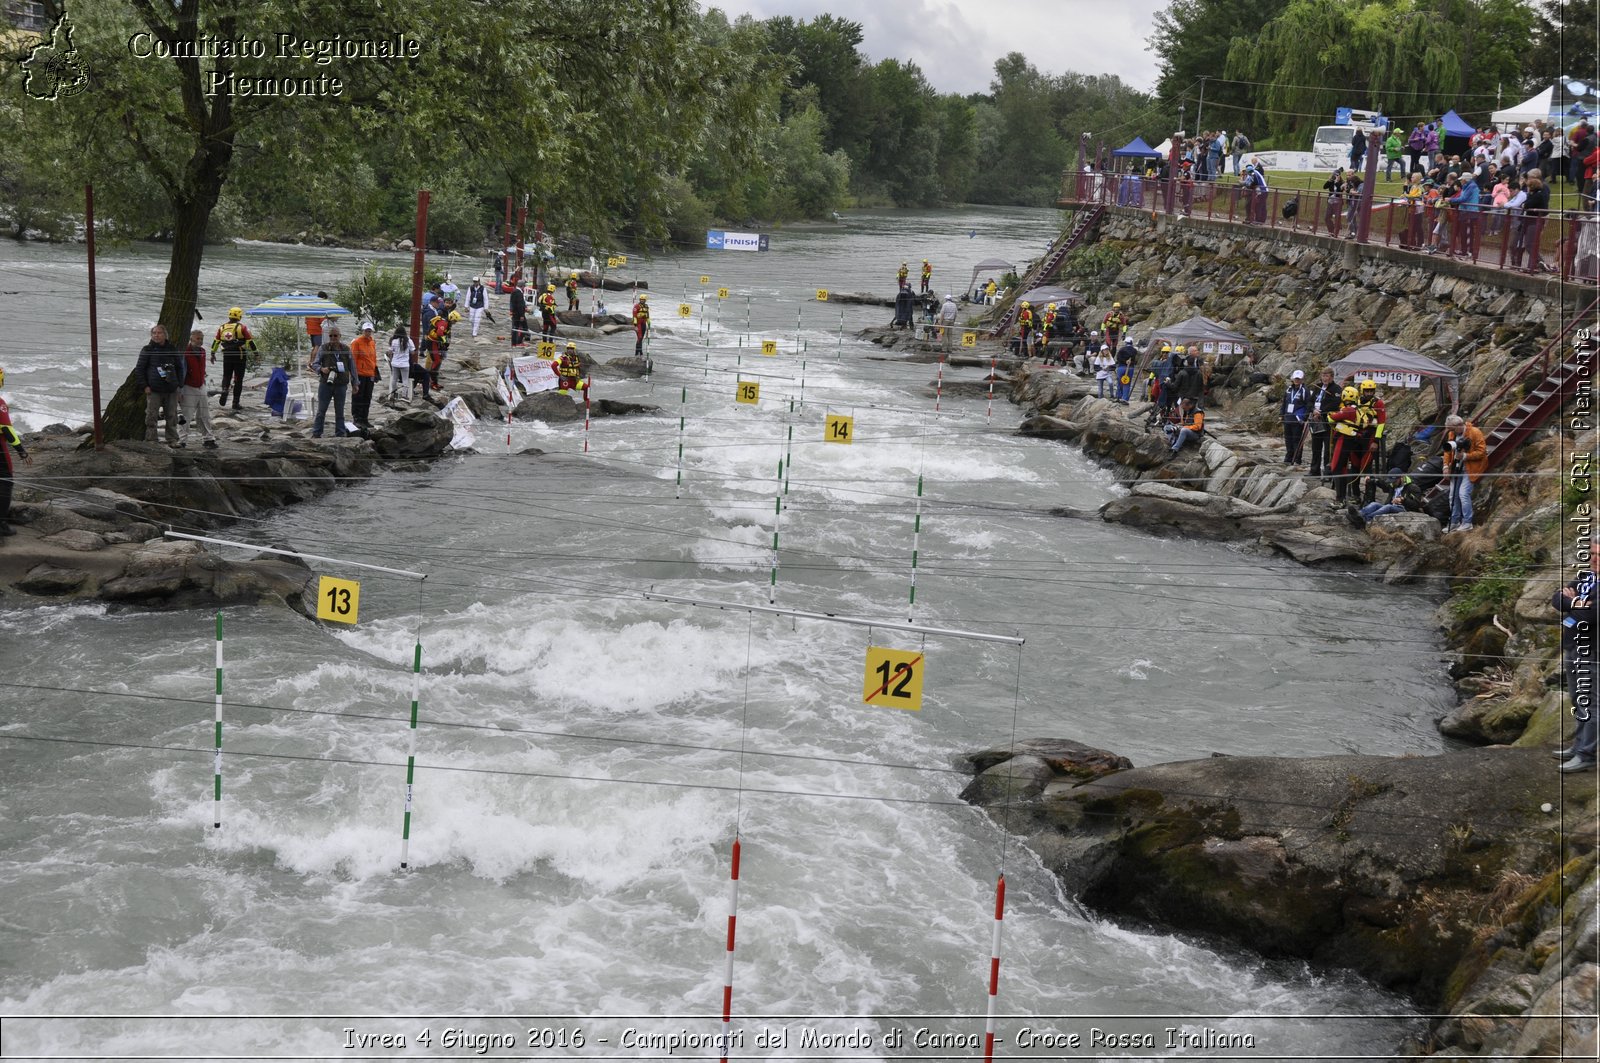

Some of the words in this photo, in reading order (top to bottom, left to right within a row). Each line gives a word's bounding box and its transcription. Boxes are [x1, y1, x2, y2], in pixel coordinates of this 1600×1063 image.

[724, 238, 758, 246] FINISH
[818, 290, 827, 299] 20
[681, 306, 690, 315] 19
[965, 335, 973, 345] 18
[541, 345, 553, 358] 16
[765, 343, 774, 353] 17
[1375, 370, 1386, 378] 15
[1390, 373, 1402, 381] 16
[1407, 374, 1420, 382] 17
[742, 385, 756, 400] 15
[831, 420, 849, 439] 14
[327, 586, 351, 615] 13
[876, 660, 913, 699] 12
